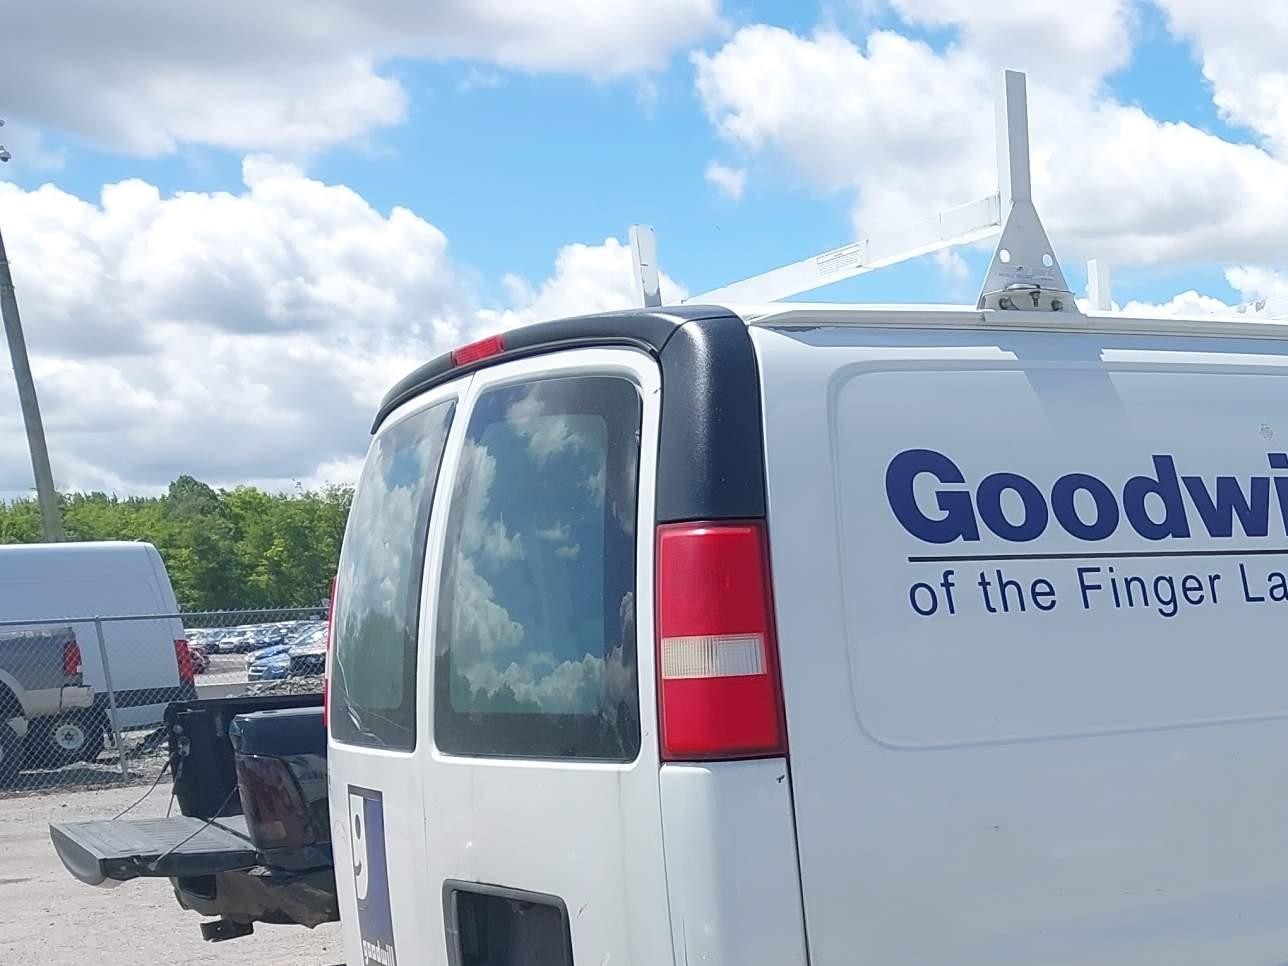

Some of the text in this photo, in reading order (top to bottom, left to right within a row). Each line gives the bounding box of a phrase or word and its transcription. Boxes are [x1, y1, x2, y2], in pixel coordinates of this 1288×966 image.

[909, 569, 956, 617] of
[978, 568, 1057, 614] the
[1076, 566, 1222, 618] Finger
